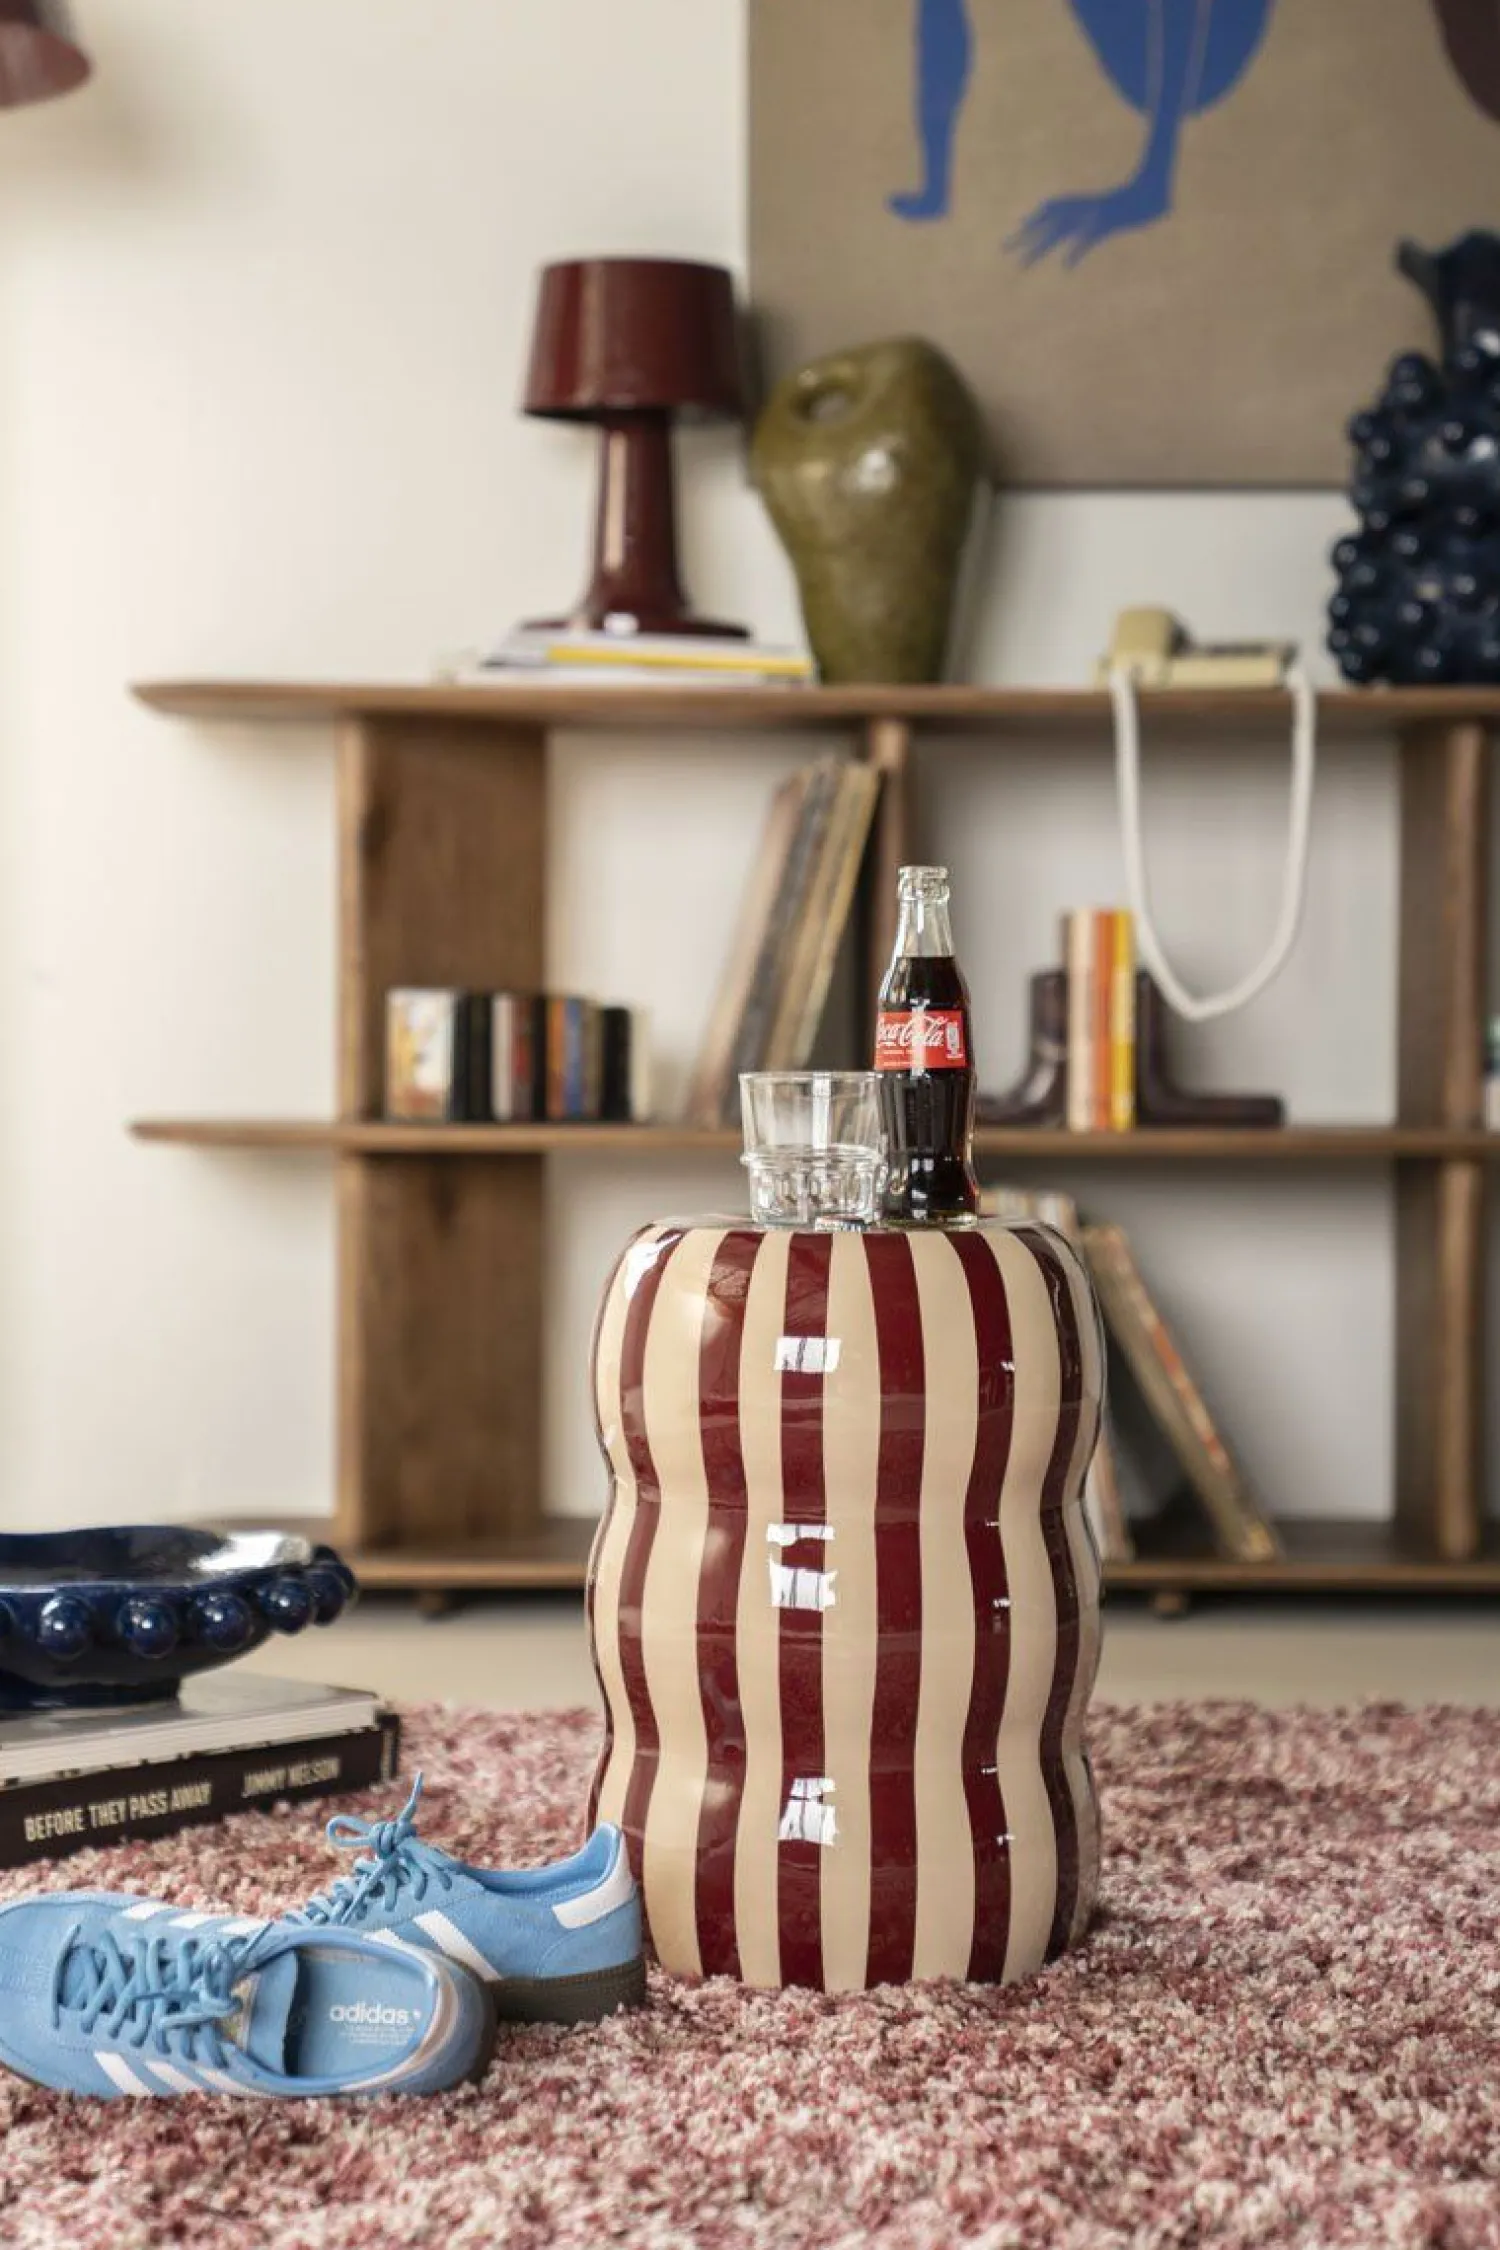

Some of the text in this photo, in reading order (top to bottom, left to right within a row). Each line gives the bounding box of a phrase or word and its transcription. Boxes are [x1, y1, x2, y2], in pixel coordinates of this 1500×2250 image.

[24, 1782, 212, 1842] BEFORE THEY PASS AWAY
[329, 2001, 410, 2024] adidas
